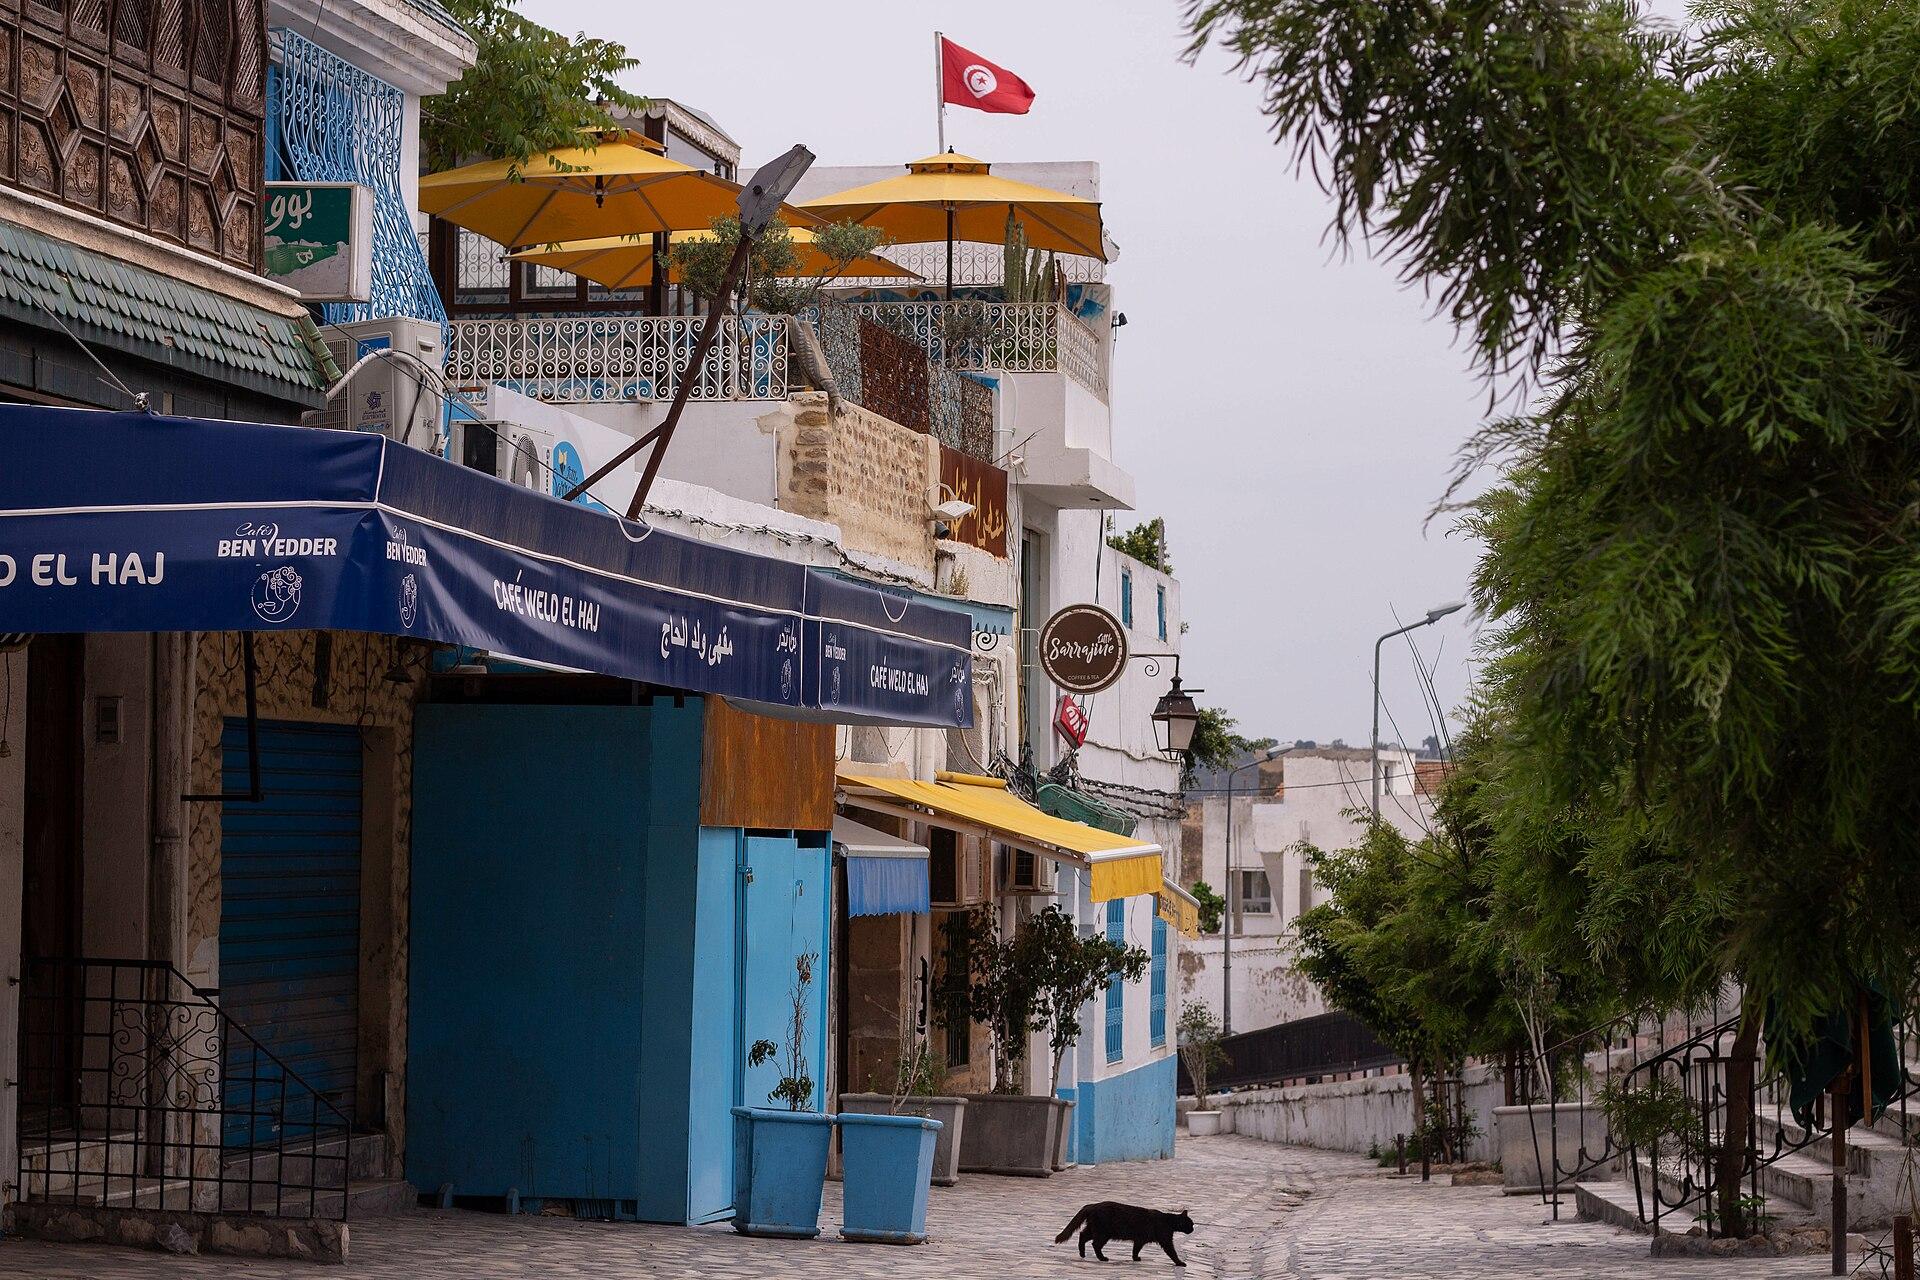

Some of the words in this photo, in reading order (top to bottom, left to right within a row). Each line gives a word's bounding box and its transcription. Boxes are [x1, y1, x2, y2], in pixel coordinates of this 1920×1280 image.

[217, 539, 256, 557] BEN
[261, 524, 337, 556] YEDDER
[386, 541, 400, 561] BEN
[401, 529, 427, 567] YEDDER
[31, 553, 78, 586] EL
[91, 552, 165, 585] HAJ
[493, 569, 524, 615] CAFÉ
[524, 586, 559, 623] WELD
[562, 596, 576, 627] EL
[578, 600, 600, 633] HAJ
[660, 615, 687, 659] الحاج
[691, 619, 706, 660] ولد
[1049, 637, 1114, 664] Sarrajine
[870, 655, 887, 690] CAFÉ
[888, 667, 906, 693] WELD
[907, 672, 915, 694] EL
[916, 673, 929, 697] HAJ
